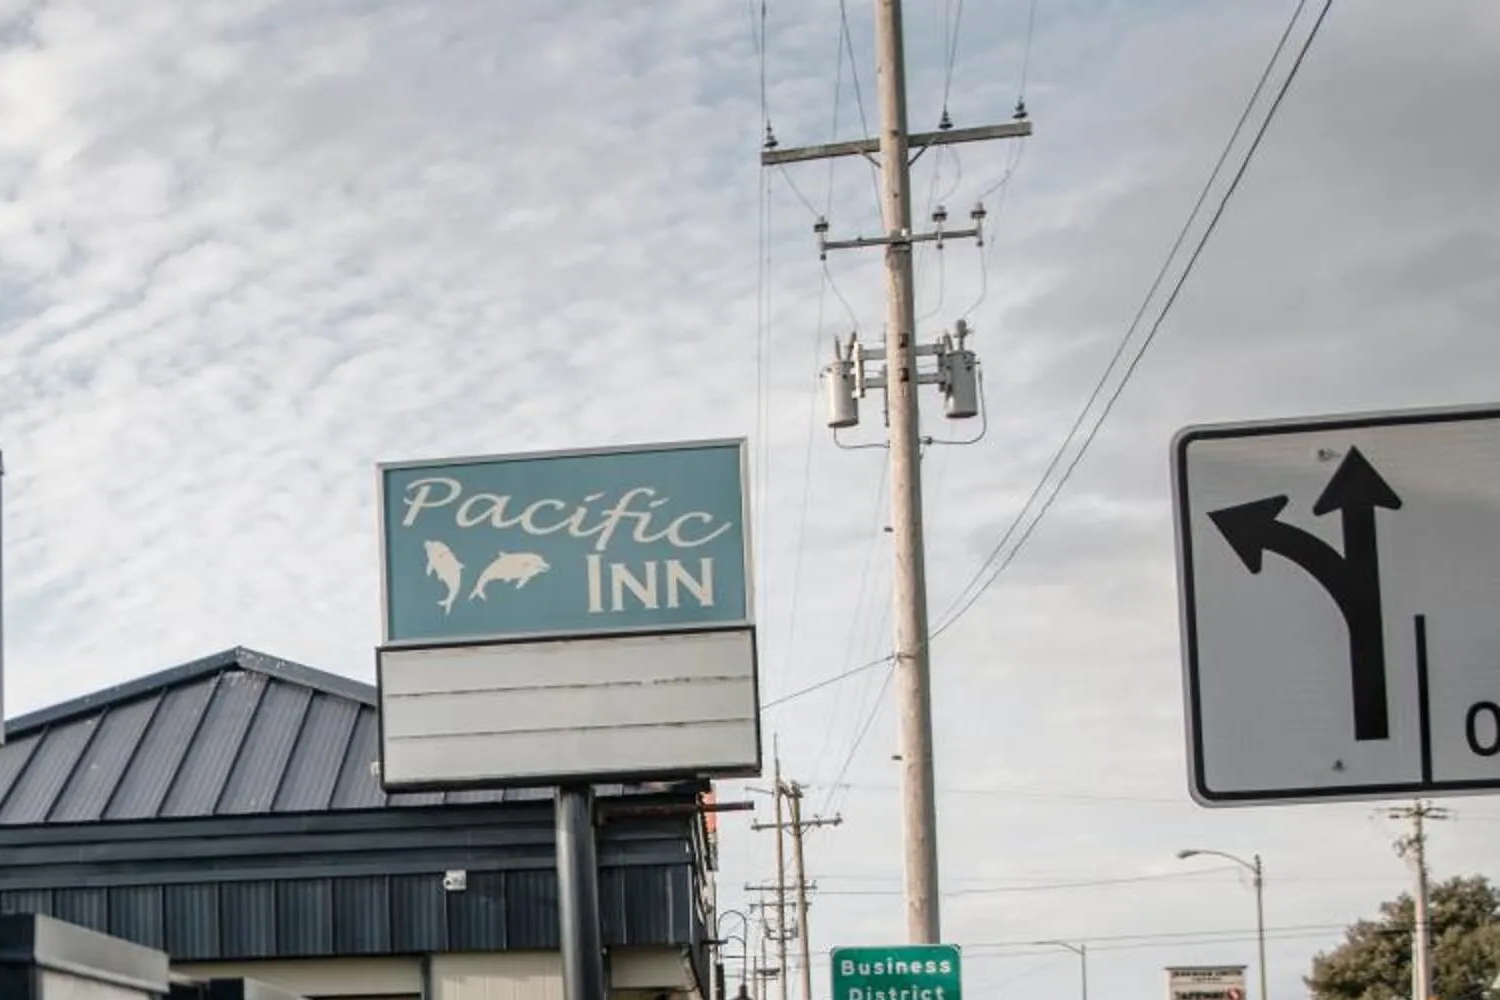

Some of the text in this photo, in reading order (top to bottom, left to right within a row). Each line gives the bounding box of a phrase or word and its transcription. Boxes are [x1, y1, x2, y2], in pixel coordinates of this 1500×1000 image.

[402, 477, 733, 551] Pacific
[586, 553, 716, 614] INN
[840, 957, 952, 976] Business
